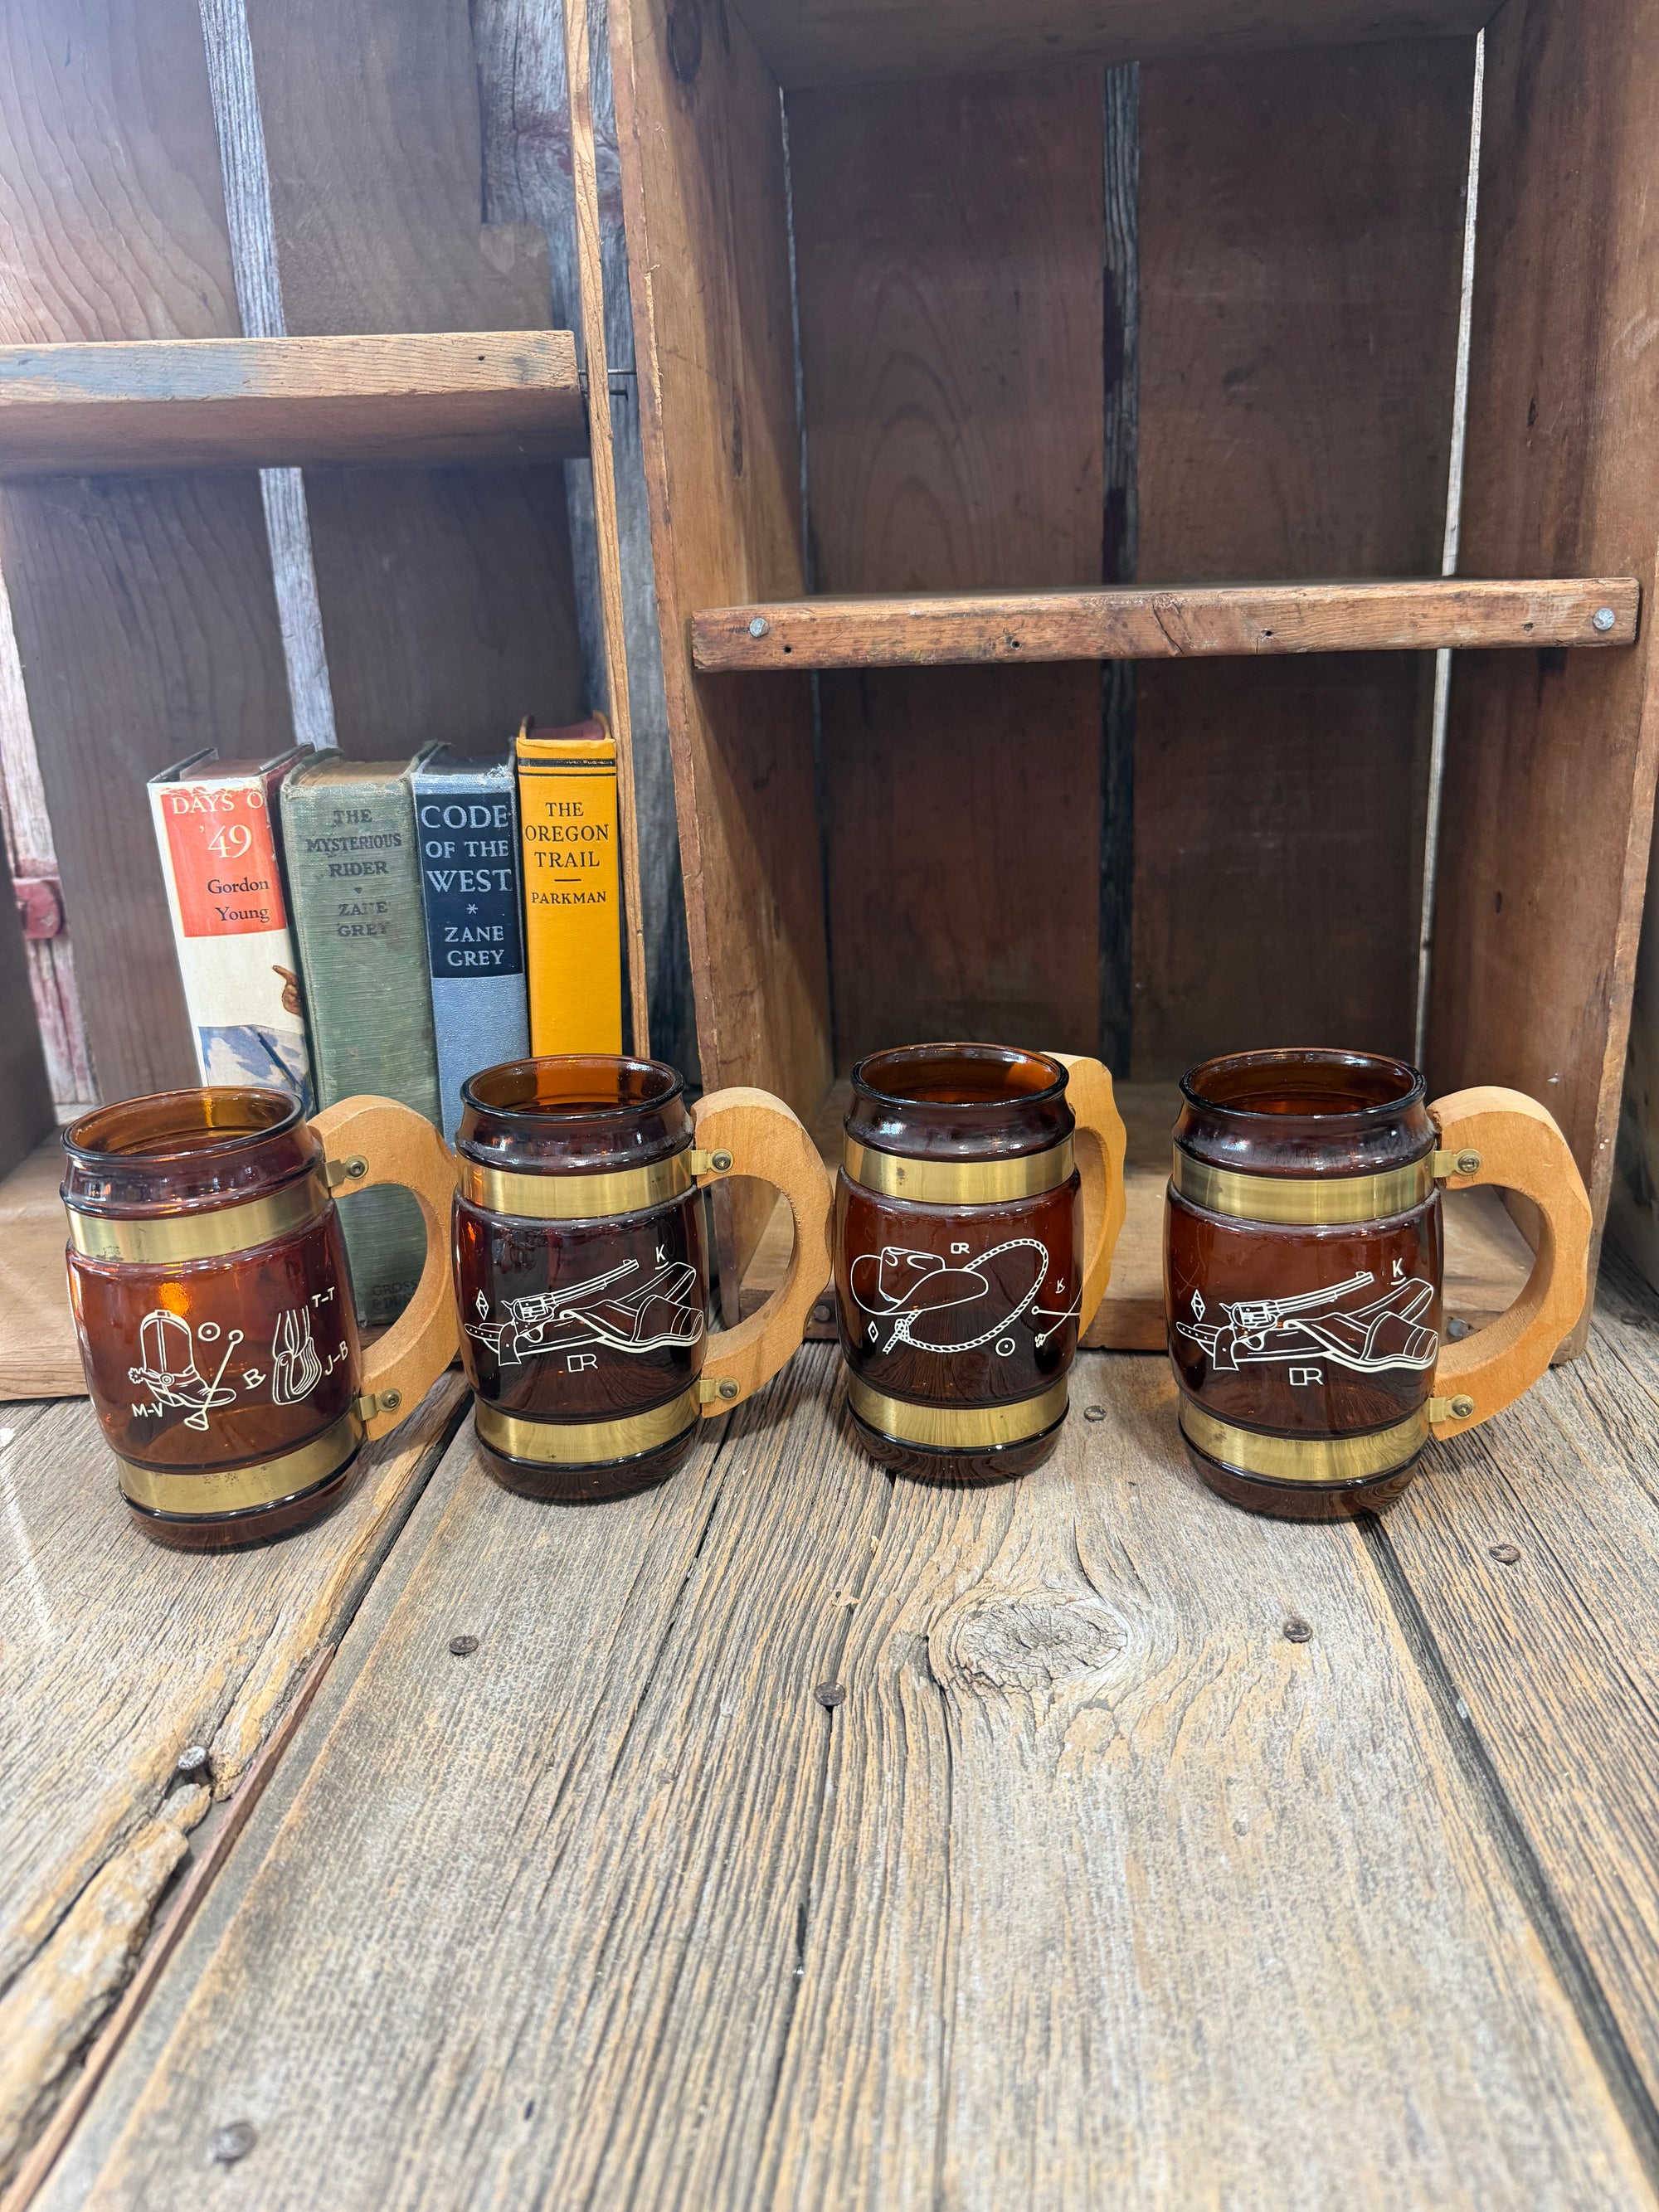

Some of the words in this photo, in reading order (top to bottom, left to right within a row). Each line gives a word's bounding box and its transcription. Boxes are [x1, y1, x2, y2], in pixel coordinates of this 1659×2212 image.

[172, 793, 235, 814] DAYS
[246, 791, 265, 809] O
[545, 802, 584, 817] THE
[333, 809, 372, 824] THE
[421, 805, 509, 829] CODE
[525, 824, 609, 842] OREGON
[305, 834, 401, 853] MYSTERIOUS
[426, 841, 455, 858] OF
[464, 840, 509, 858] THE
[534, 852, 600, 868] TRAIL
[328, 861, 389, 878] RIDER
[207, 877, 270, 894] Gordon
[426, 869, 513, 892] WEST
[532, 892, 606, 904] PARKMAN
[215, 907, 270, 923] Young
[445, 926, 504, 942] ZANE
[447, 950, 504, 966] GREY
[373, 1280, 418, 1296] GROSS
[131, 1403, 164, 1418] M-V
